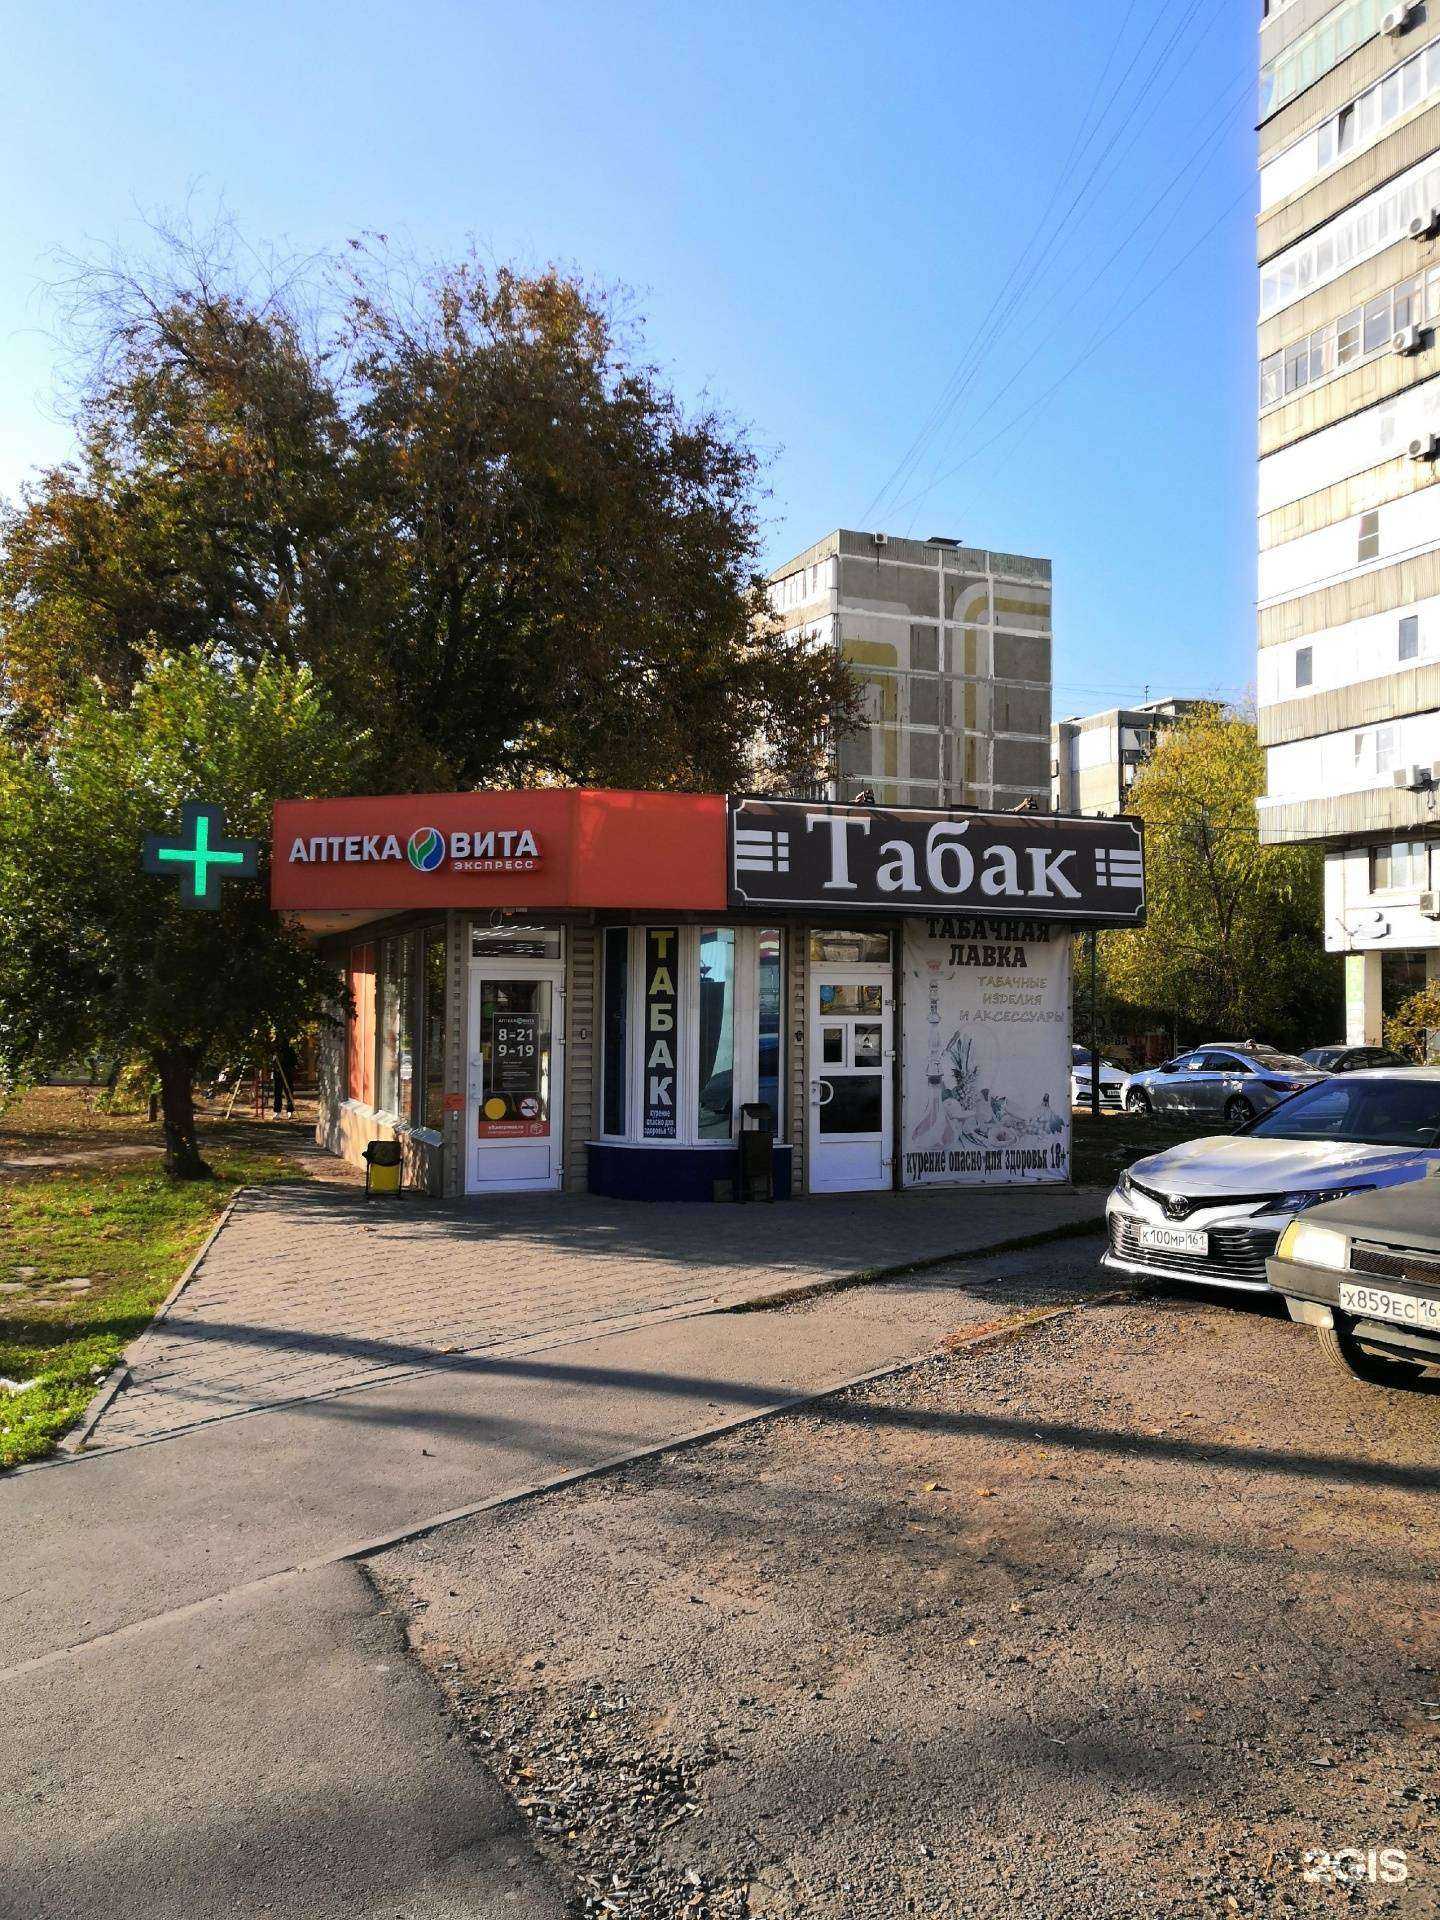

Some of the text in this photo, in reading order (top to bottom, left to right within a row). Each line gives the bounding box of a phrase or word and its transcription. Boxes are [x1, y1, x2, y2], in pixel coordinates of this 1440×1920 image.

[288, 829, 539, 862] АПТЕКА ВИТА
[806, 813, 1082, 898] Табак
[453, 860, 535, 870] ЭКСПРЕСС
[927, 917, 1050, 942] ТАБАЧНАЯ
[949, 944, 1028, 968] ЛАВКА
[977, 975, 1048, 989] ТАБАЧНЫЕ
[648, 930, 676, 1105] ТАБАК
[959, 1009, 1065, 1023] И АКСЕССУАРЫ
[906, 1142, 1067, 1181] курение опасно для здоровья 18+
[1346, 1290, 1416, 1319] Х859ЕС
